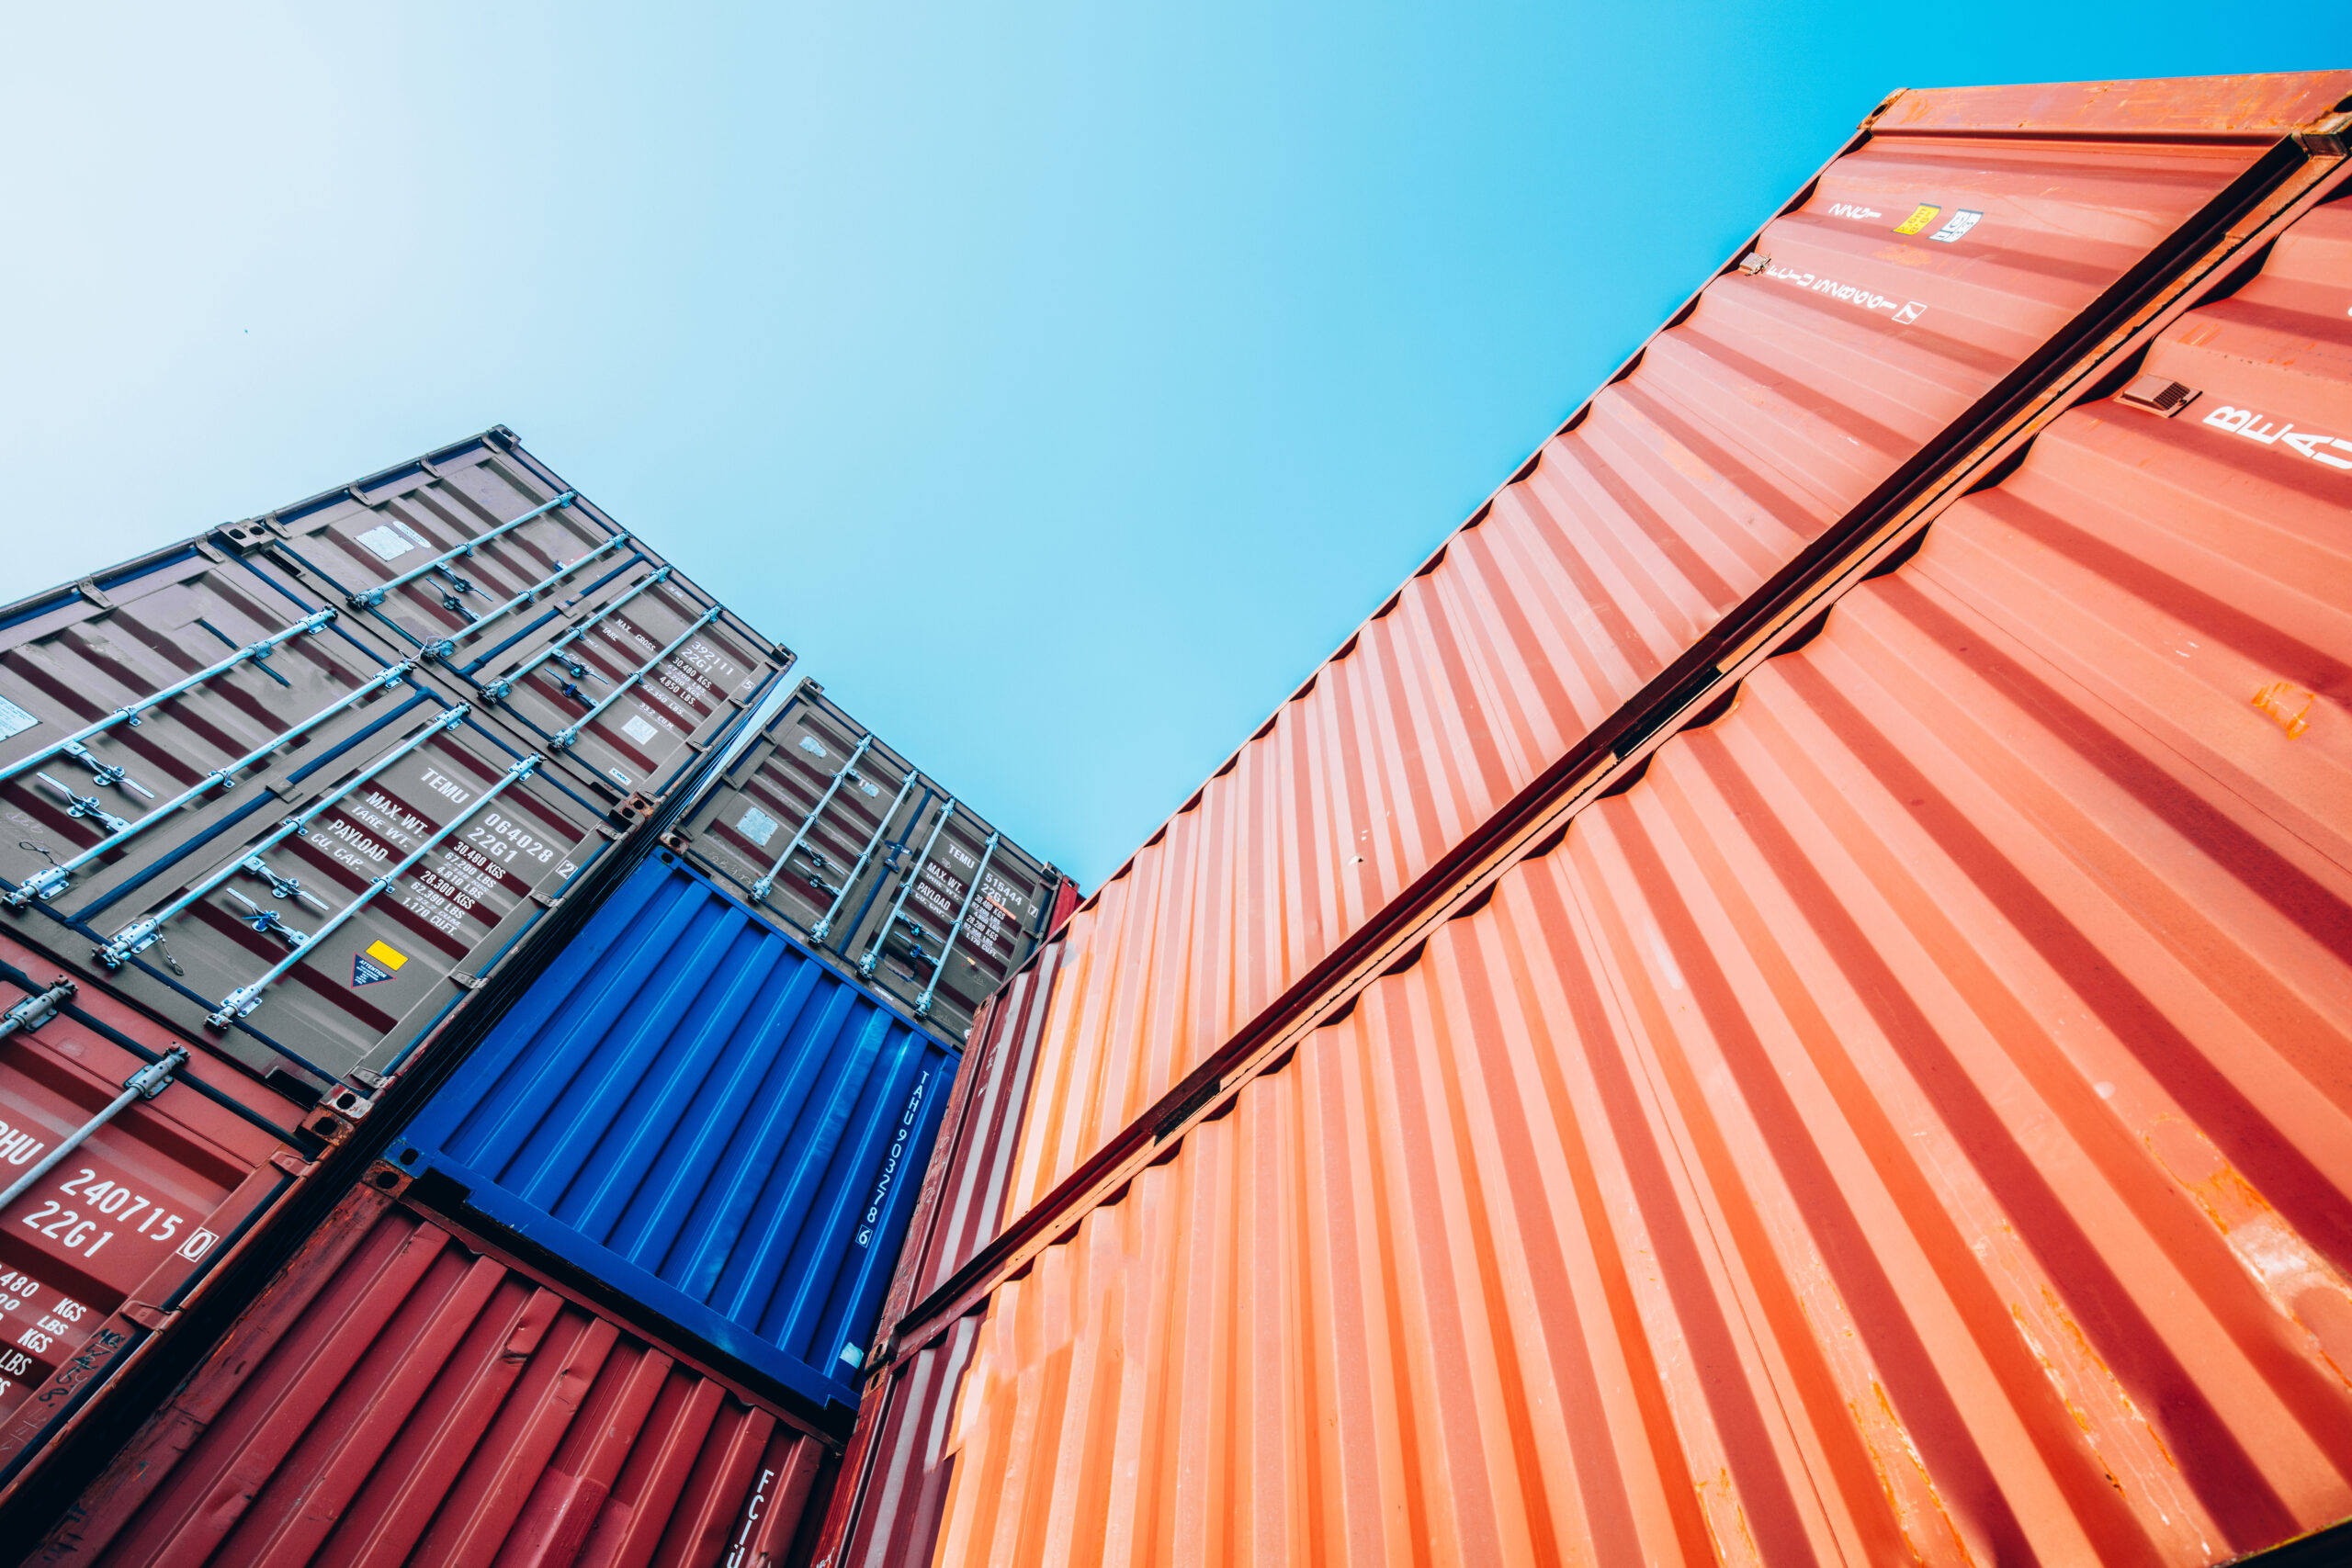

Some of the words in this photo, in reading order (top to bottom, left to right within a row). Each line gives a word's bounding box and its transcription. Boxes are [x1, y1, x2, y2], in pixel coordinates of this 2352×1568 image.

[1828, 203, 1882, 220] 22G1
[1766, 265, 1815, 287] FCIU
[1812, 278, 1897, 310] 528661
[1893, 302, 1925, 324] 7
[635, 634, 656, 651] GROSS
[673, 657, 697, 677] 30.480
[696, 675, 713, 691] KGS.
[681, 648, 713, 672] 22G1
[691, 641, 734, 675] 392111
[660, 676, 680, 694] 4.850
[680, 692, 696, 707] LBS.
[352, 805, 386, 829] TARE
[385, 828, 412, 848] WT.
[366, 792, 402, 821] MAX.
[401, 814, 428, 838] WT.
[453, 841, 487, 867] 30.480
[485, 862, 506, 879] KGS
[421, 768, 469, 804] TEMU
[484, 813, 553, 863] 064028
[558, 862, 577, 879] 2
[311, 833, 333, 851] CU.
[334, 848, 364, 871] CAP.
[467, 827, 518, 863] 22G1
[327, 819, 389, 862] PAYLOAD
[420, 870, 455, 897] 28.300
[453, 891, 476, 909] KGS
[437, 866, 464, 886] 4.810
[462, 883, 483, 899] LBS
[445, 852, 477, 875] 67.200
[476, 872, 497, 888] LBS
[948, 844, 976, 869] TEMU
[985, 873, 1023, 906] 515444
[401, 897, 431, 918] 1.170
[411, 881, 445, 906] 62.390
[444, 903, 465, 919] LBS
[927, 862, 947, 883] MAX.
[946, 876, 963, 894] WT.
[975, 894, 993, 911] 30.480
[992, 908, 1006, 920] KGS
[980, 884, 1007, 906] 22G1
[917, 882, 951, 910] PAYLOAD
[985, 928, 999, 942] KGS
[359, 959, 387, 977] ATTENTION
[904, 1071, 929, 1125] TAHU
[866, 1129, 907, 1224] 903278
[22, 1201, 114, 1258] 22G1
[60, 1168, 183, 1240] 240715
[180, 1230, 215, 1260] 0
[857, 1227, 872, 1247] 6
[37, 1315, 68, 1336] LBS
[52, 1298, 86, 1322] KGS
[17, 1328, 53, 1353] KGS
[0, 1349, 32, 1375] LBS
